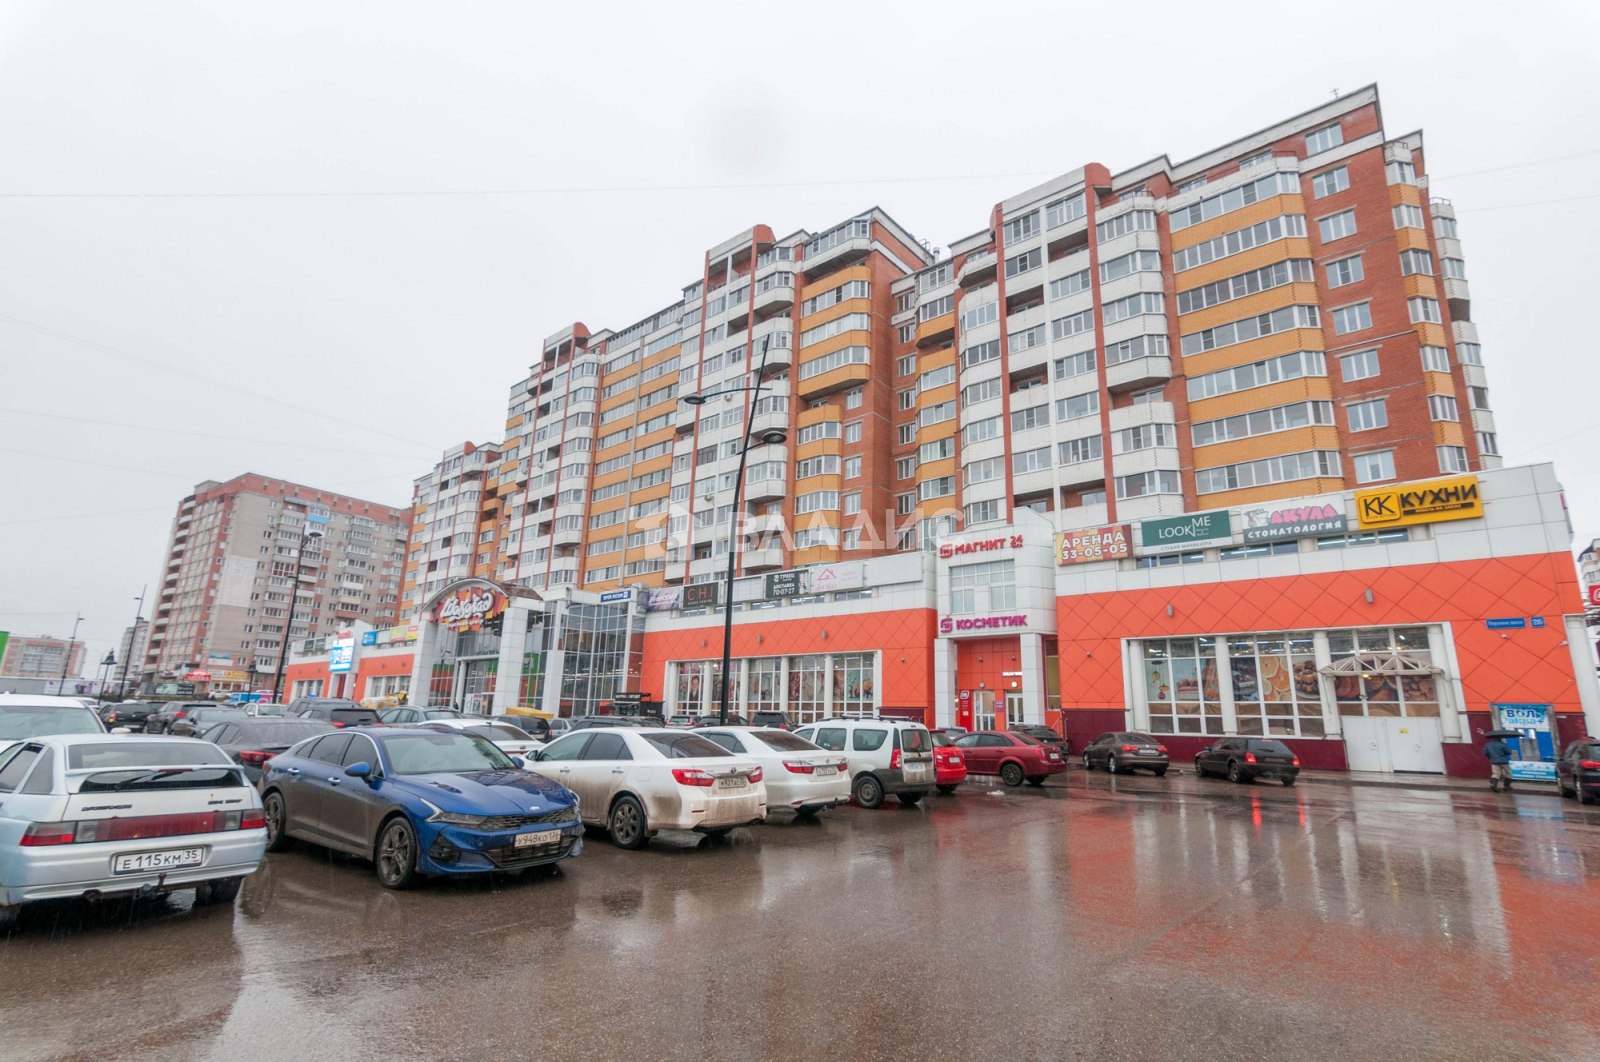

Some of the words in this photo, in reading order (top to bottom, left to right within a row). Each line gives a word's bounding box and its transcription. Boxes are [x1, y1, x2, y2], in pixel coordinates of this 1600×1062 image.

[1399, 483, 1478, 508] КУХНИ
[1270, 503, 1339, 524] АКУЛА
[1158, 524, 1194, 539] LOOK
[1247, 520, 1342, 539] СТОМАТОЛОГИЯ
[954, 538, 1006, 555] МАГНИТ
[1061, 531, 1125, 549] АРЕНДА
[1181, 540, 1212, 549] МАНИКЮРА
[1061, 543, 1128, 560] 33-05-05
[773, 582, 795, 590] ДОСТАВКА
[773, 588, 795, 596] 70-07-27
[956, 615, 1028, 630] КОСМЕТИК
[184, 850, 198, 860] 35
